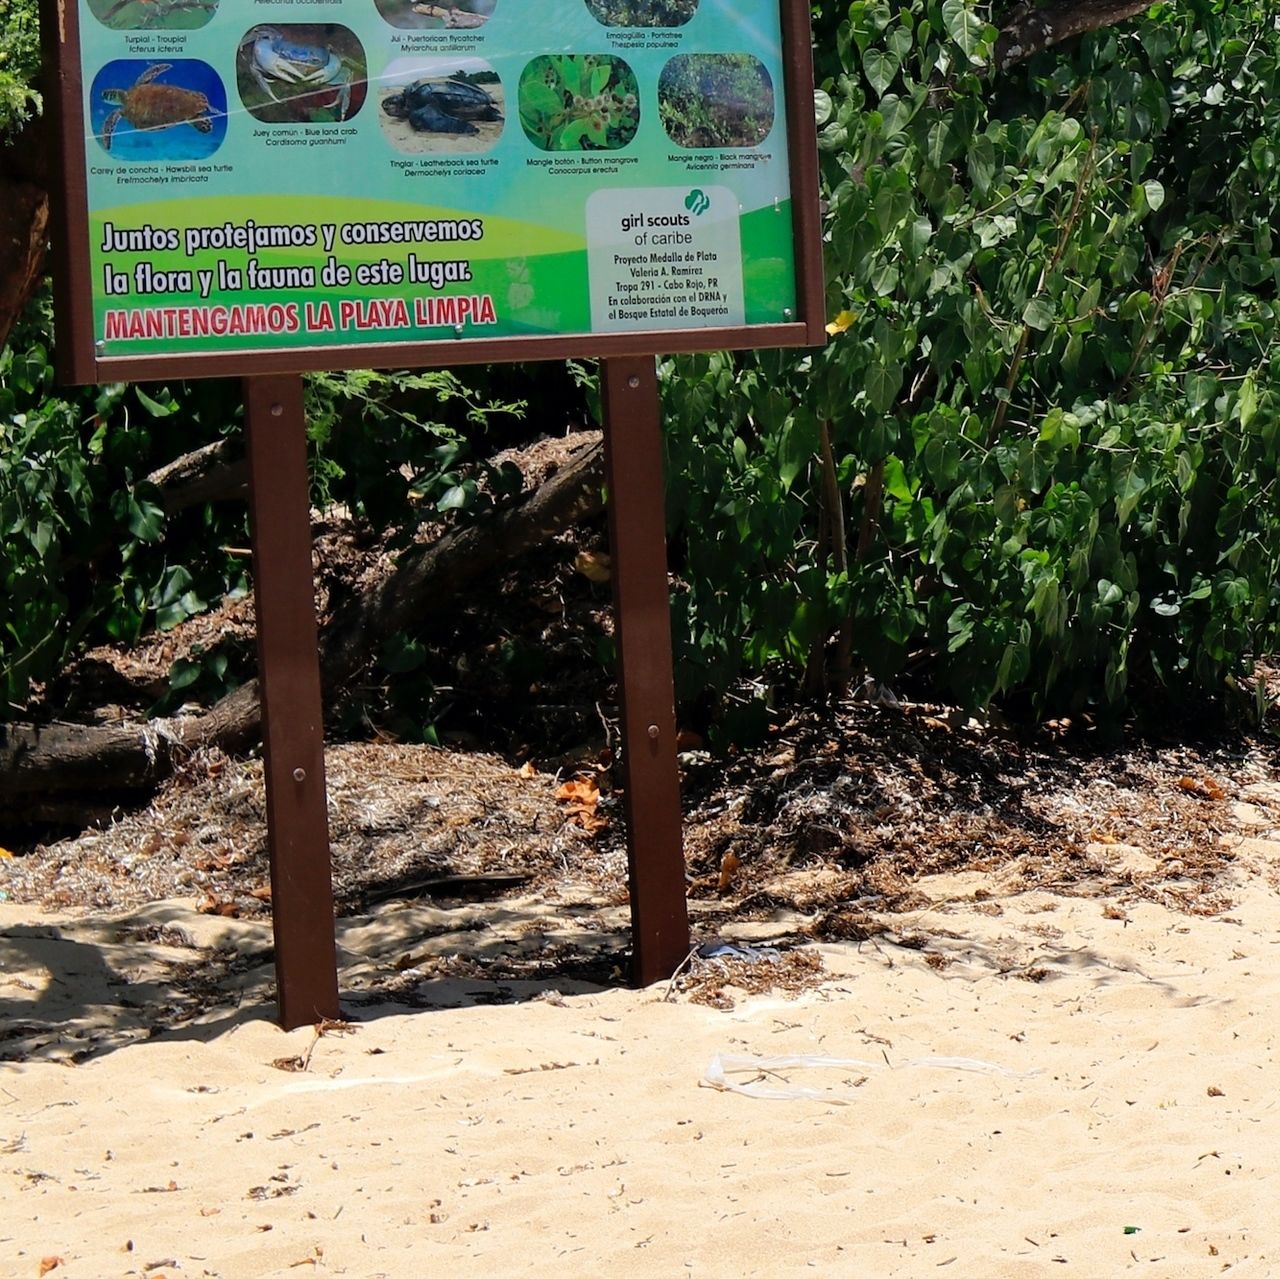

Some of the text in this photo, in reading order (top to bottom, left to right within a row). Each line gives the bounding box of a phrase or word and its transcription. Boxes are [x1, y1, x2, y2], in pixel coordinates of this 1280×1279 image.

[125, 35, 150, 43] Turpial
[129, 45, 183, 53] Icterus icterus
[305, 128, 320, 136] Blue
[526, 158, 553, 167] Mangle
[668, 154, 693, 162] Mangle
[390, 160, 414, 168] Tinglar
[420, 159, 464, 167] Leatherback
[720, 163, 755, 171] germinans
[90, 167, 114, 175] Carey
[129, 166, 158, 174] concha
[404, 169, 451, 177] Dermochelys
[548, 167, 591, 175] Conocarpus
[170, 175, 209, 183] imbricata
[621, 213, 690, 232] girl scouts
[102, 218, 483, 254] Juntos protejamos y conservemos
[634, 231, 692, 246] of caribe
[614, 251, 717, 266] Proyecto Medalla de Plata
[105, 253, 472, 298] la flora y la fauna de este lugar.
[630, 267, 658, 278] Valeria
[661, 266, 669, 276] A.
[616, 278, 718, 293] Tropa 291 Cabo Rojo, PR
[608, 292, 727, 306] En colaboración con el DRNA y
[608, 305, 728, 320] el Bosque Estatal de Boquerón
[105, 294, 497, 341] MANTENGAMOS LA PLAYA LIMPIA
